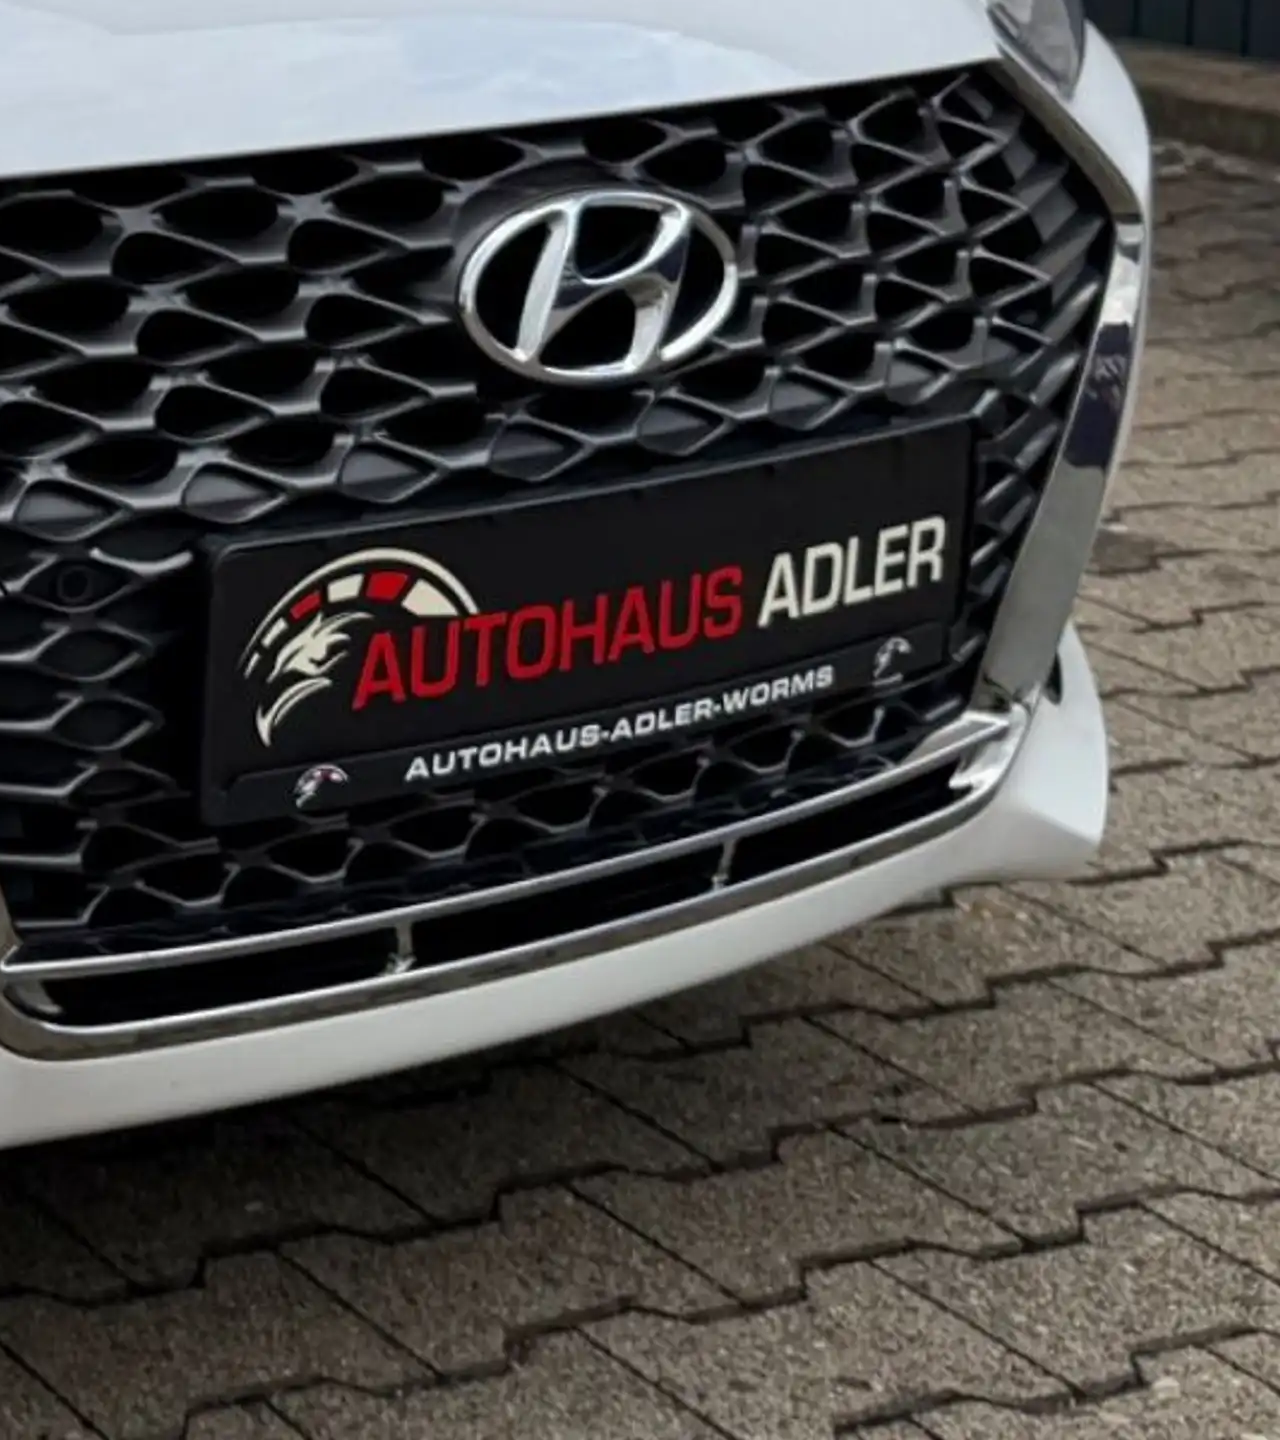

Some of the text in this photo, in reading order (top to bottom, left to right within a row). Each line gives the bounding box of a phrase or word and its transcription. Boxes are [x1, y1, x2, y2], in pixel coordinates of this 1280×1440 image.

[351, 515, 947, 710] AUTOHAUS ADLER
[404, 663, 835, 784] AUTOHAUS-ADLER-WORMS
